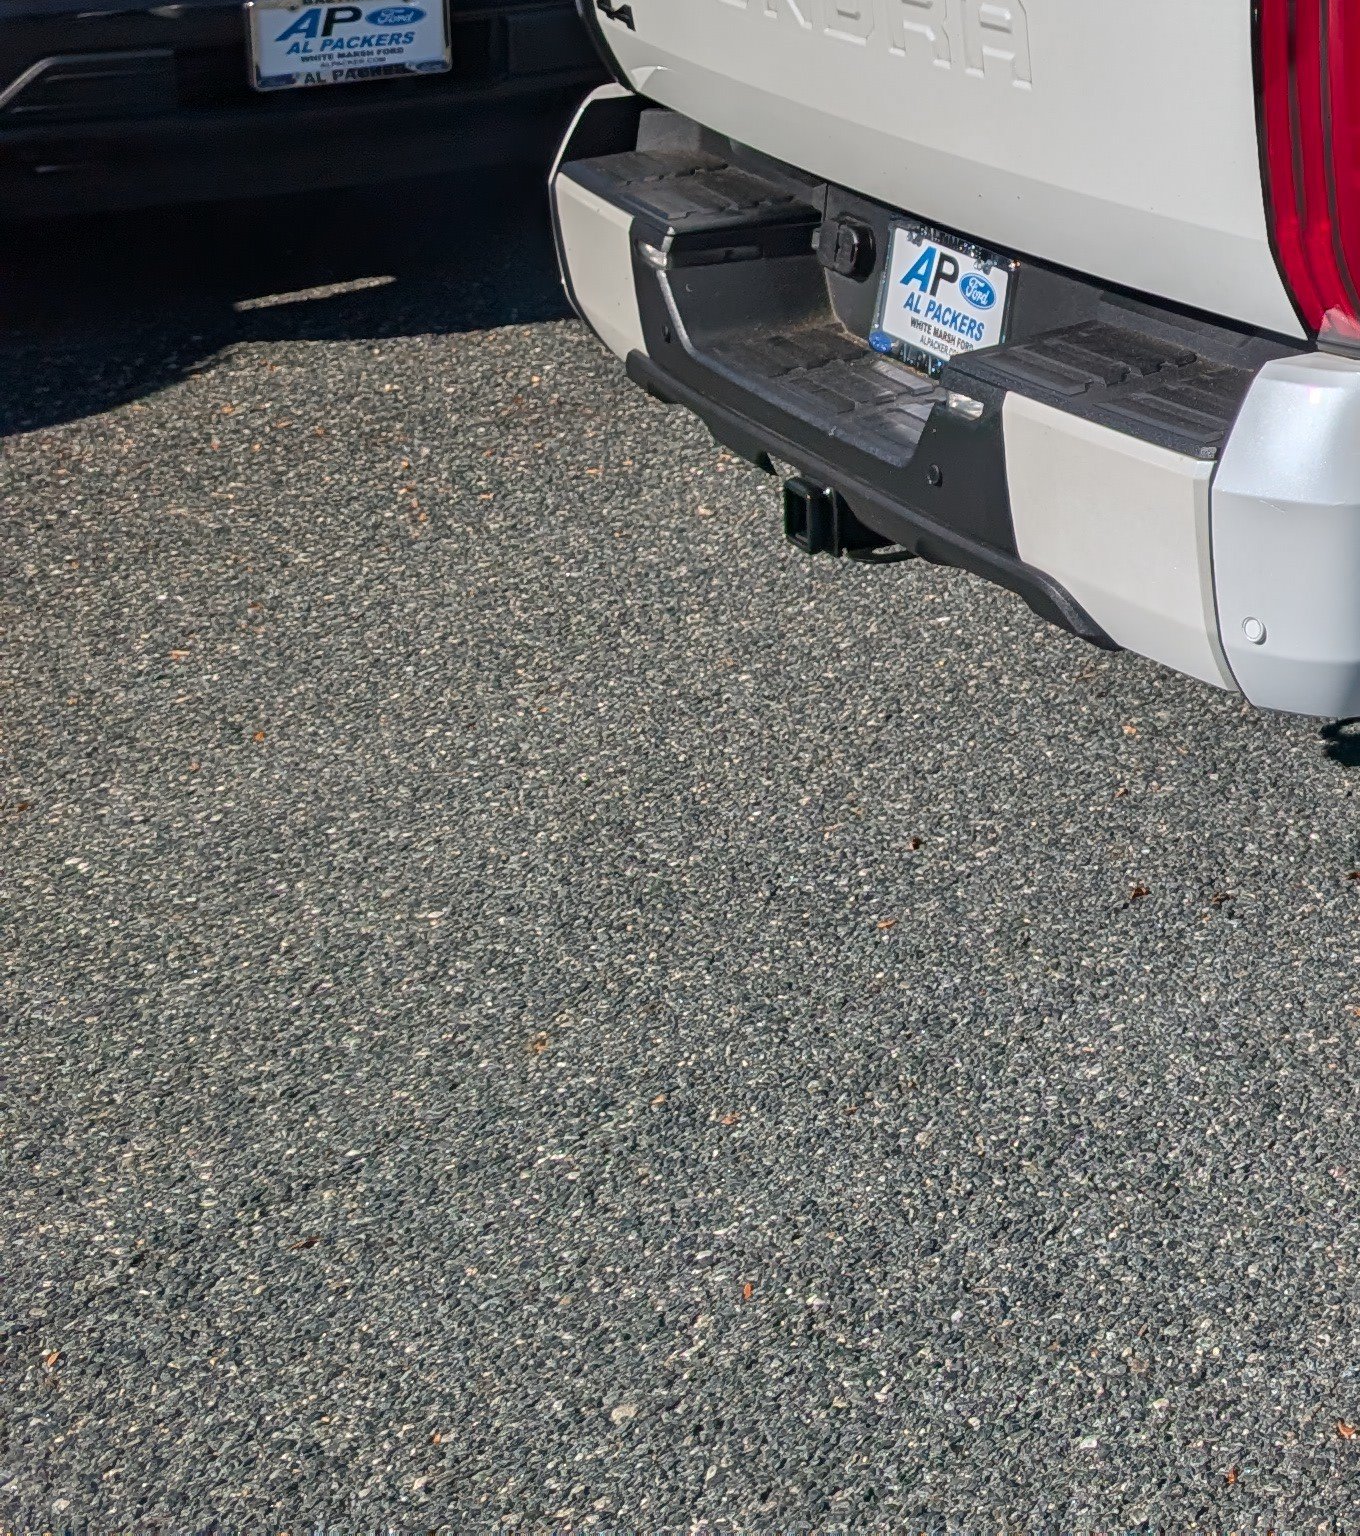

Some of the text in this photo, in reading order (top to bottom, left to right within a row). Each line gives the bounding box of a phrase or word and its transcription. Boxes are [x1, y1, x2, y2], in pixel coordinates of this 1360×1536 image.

[274, 5, 363, 42] AP
[285, 30, 416, 55] AL PACKERS
[300, 46, 404, 63] WHITE MARSH FORD
[304, 70, 327, 84] AL
[900, 245, 960, 297] AP
[964, 276, 990, 306] Ford
[902, 291, 923, 315] AL
[923, 299, 986, 342] PACKERS
[910, 315, 933, 336] WHITE
[932, 325, 957, 346] MARSH
